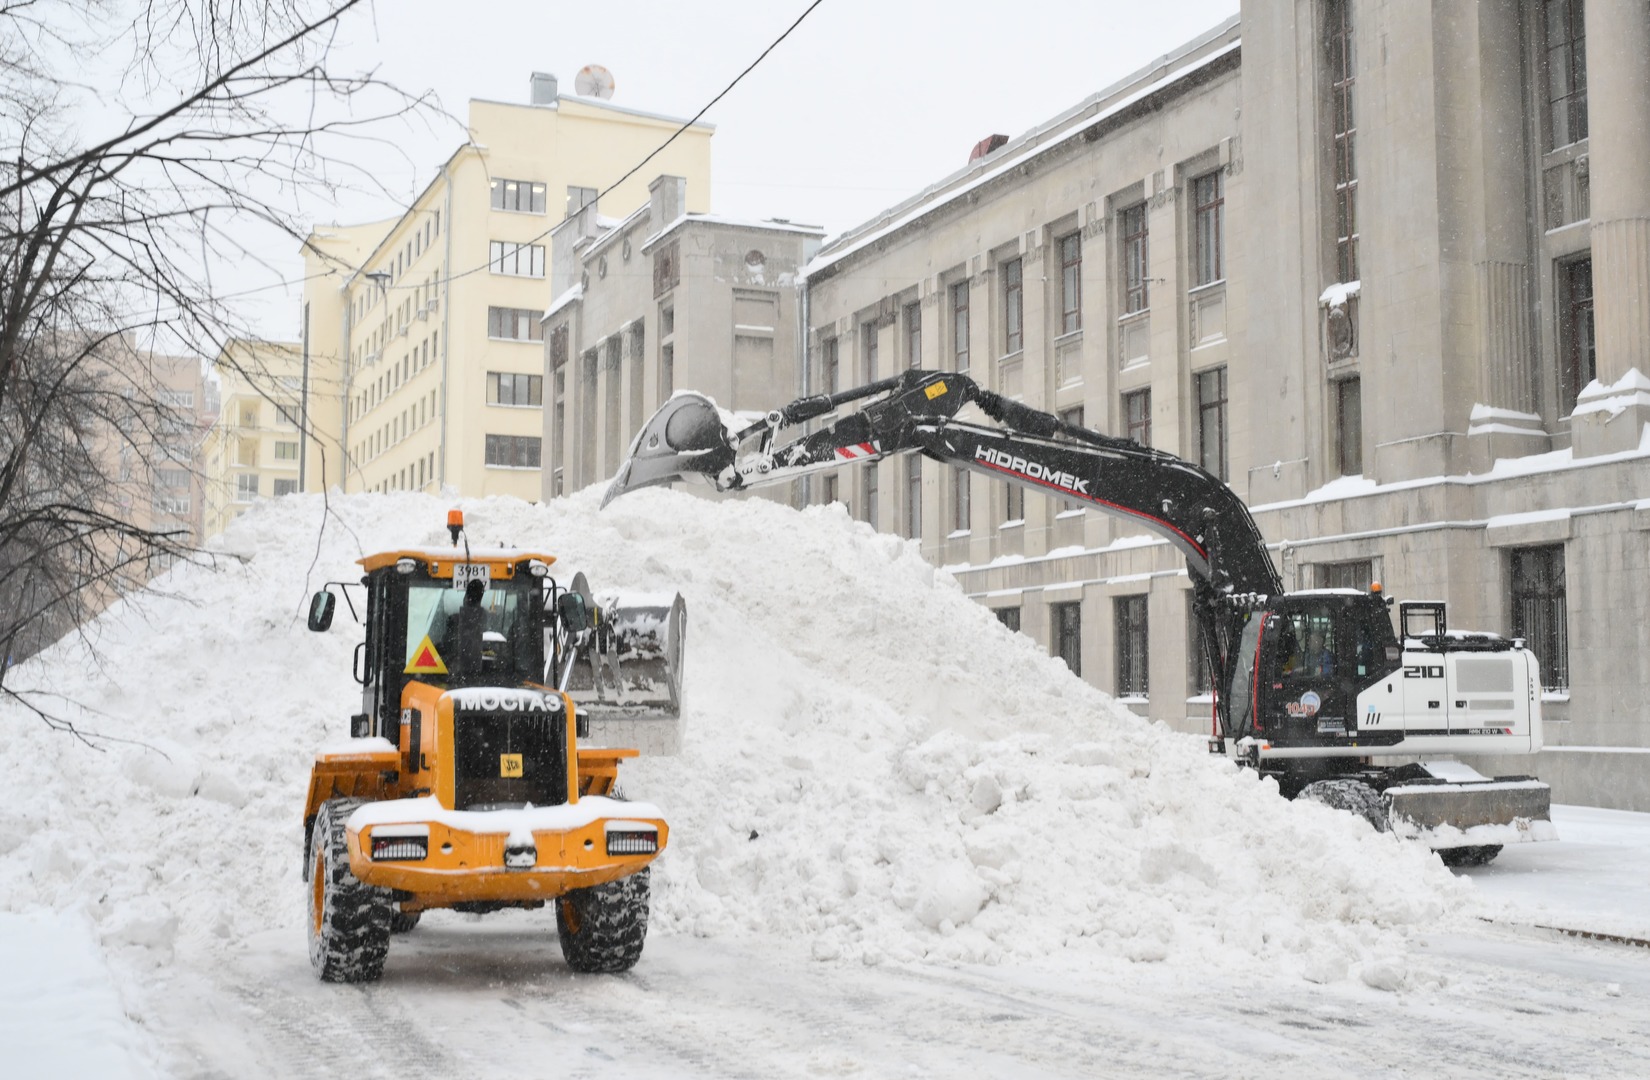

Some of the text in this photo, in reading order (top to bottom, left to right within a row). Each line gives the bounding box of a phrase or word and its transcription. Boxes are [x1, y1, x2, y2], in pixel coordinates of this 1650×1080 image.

[975, 444, 1090, 494] HIDROMEK
[1403, 665, 1444, 679] 210
[506, 760, 520, 772] JCB
